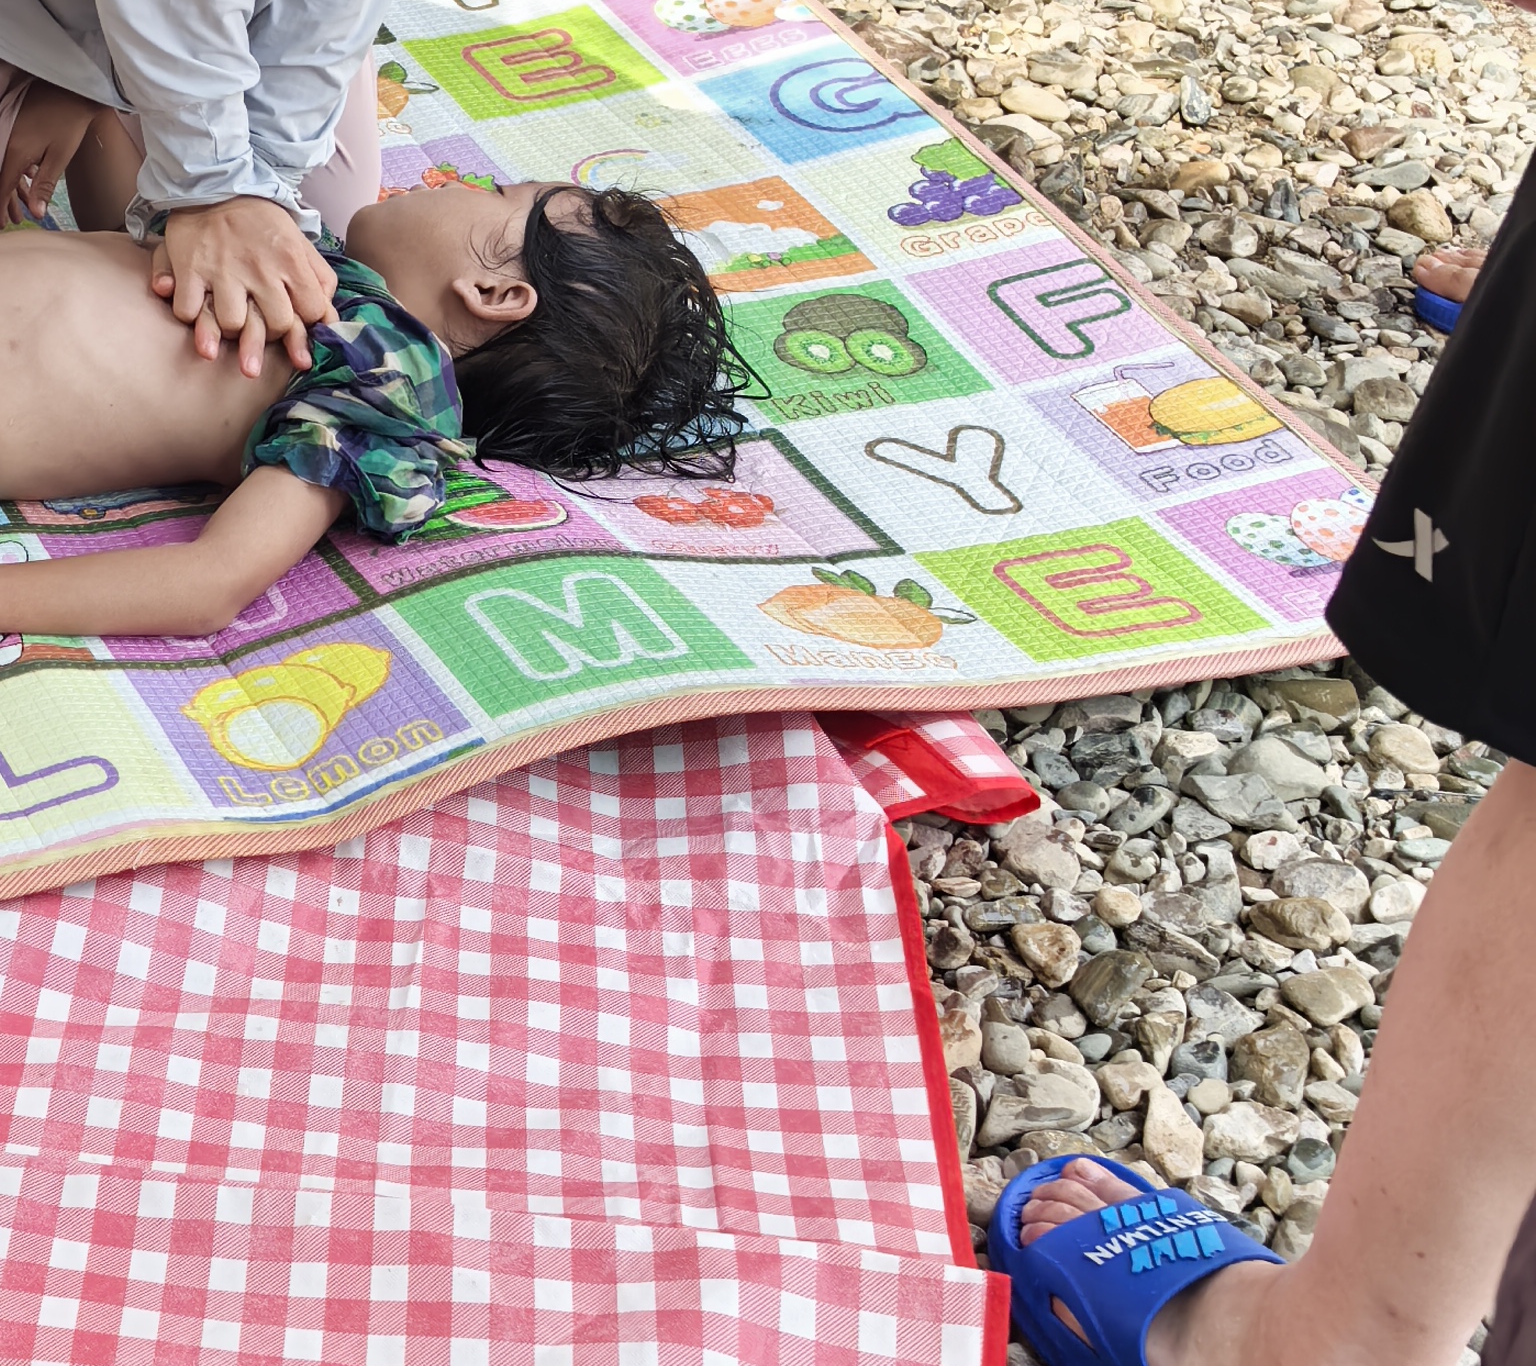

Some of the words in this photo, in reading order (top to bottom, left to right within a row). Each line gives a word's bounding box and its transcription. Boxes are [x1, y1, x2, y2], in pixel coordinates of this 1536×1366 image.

[901, 212, 1055, 257] Grape
[986, 258, 1133, 360] F
[771, 381, 896, 420] Kiwi
[865, 424, 1023, 516] Y
[1140, 439, 1294, 493] Food
[464, 571, 688, 681] M
[992, 542, 1202, 638] E
[217, 716, 444, 811] Lemon
[1083, 1209, 1228, 1266] GENTLMAN
